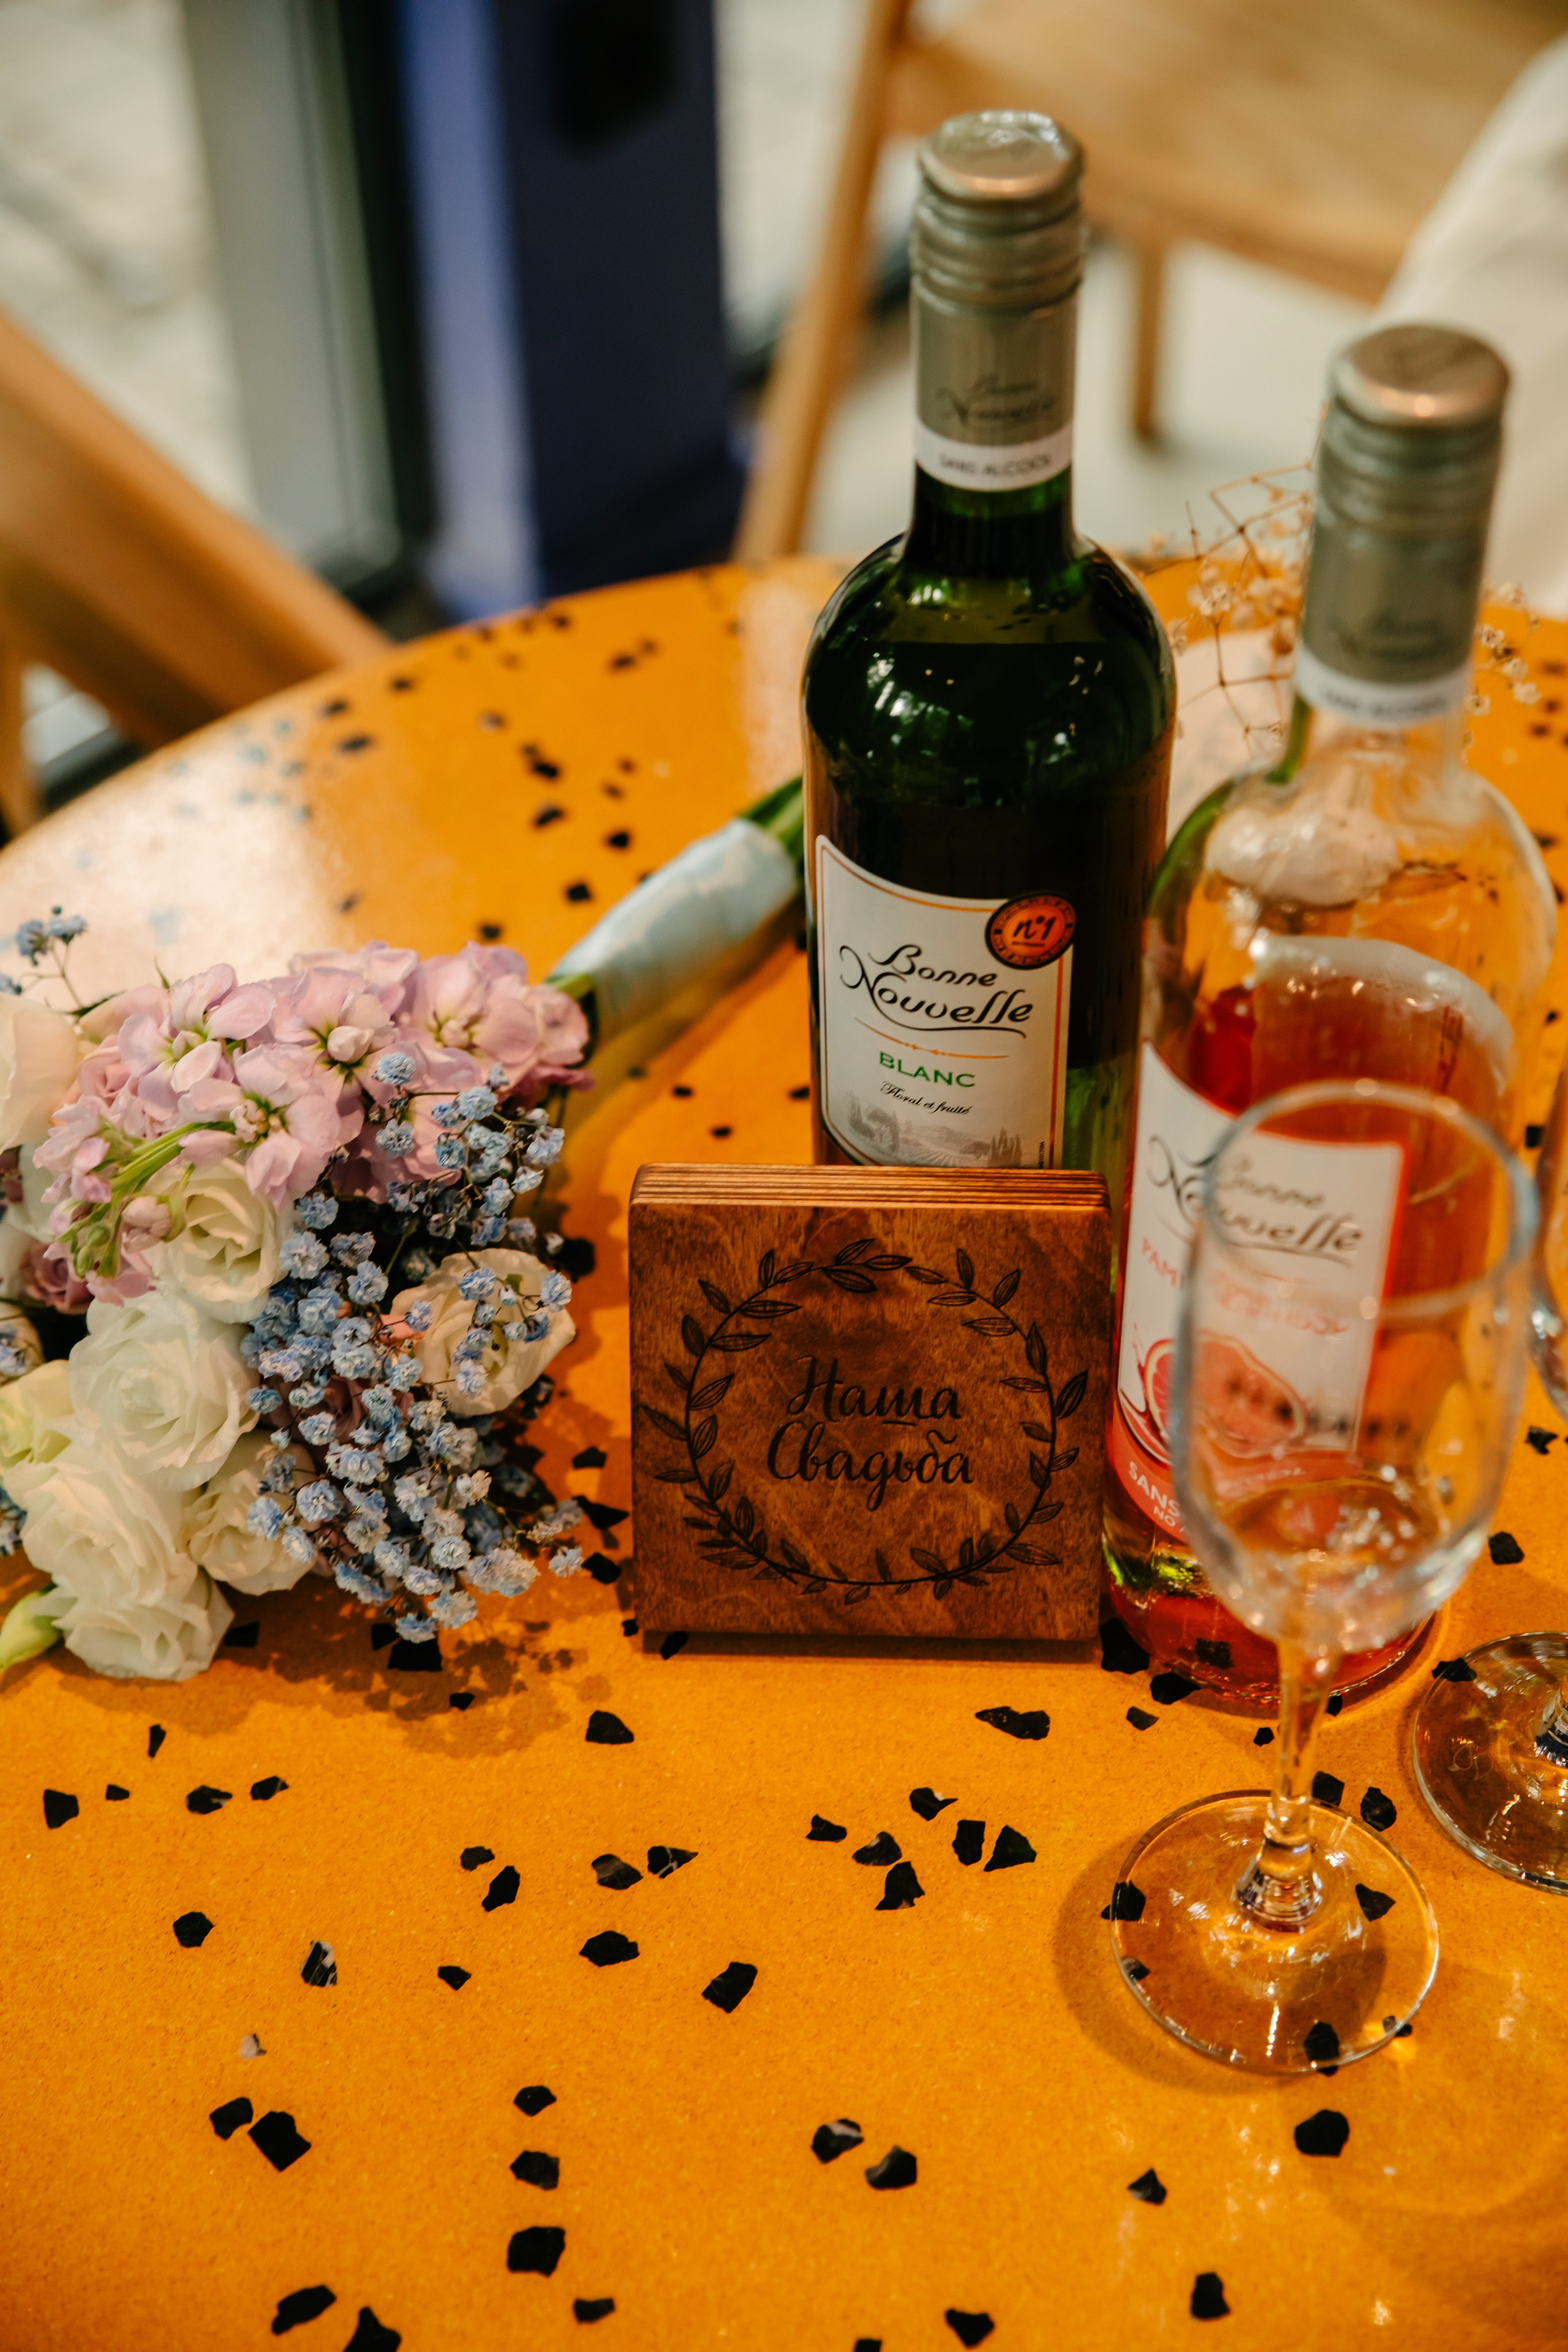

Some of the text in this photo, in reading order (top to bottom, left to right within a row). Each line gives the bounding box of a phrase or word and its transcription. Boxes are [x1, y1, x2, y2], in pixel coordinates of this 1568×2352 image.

[867, 944, 998, 987] Bonne
[839, 944, 1034, 1039] Nouvelle
[879, 1050, 976, 1088] BLANC
[880, 1080, 974, 1115] Floral et fruité
[787, 1354, 962, 1427] Наша
[767, 1420, 974, 1512] Свадьба
[1128, 1460, 1182, 1518] SANS
[1153, 1504, 1177, 1528] NO
